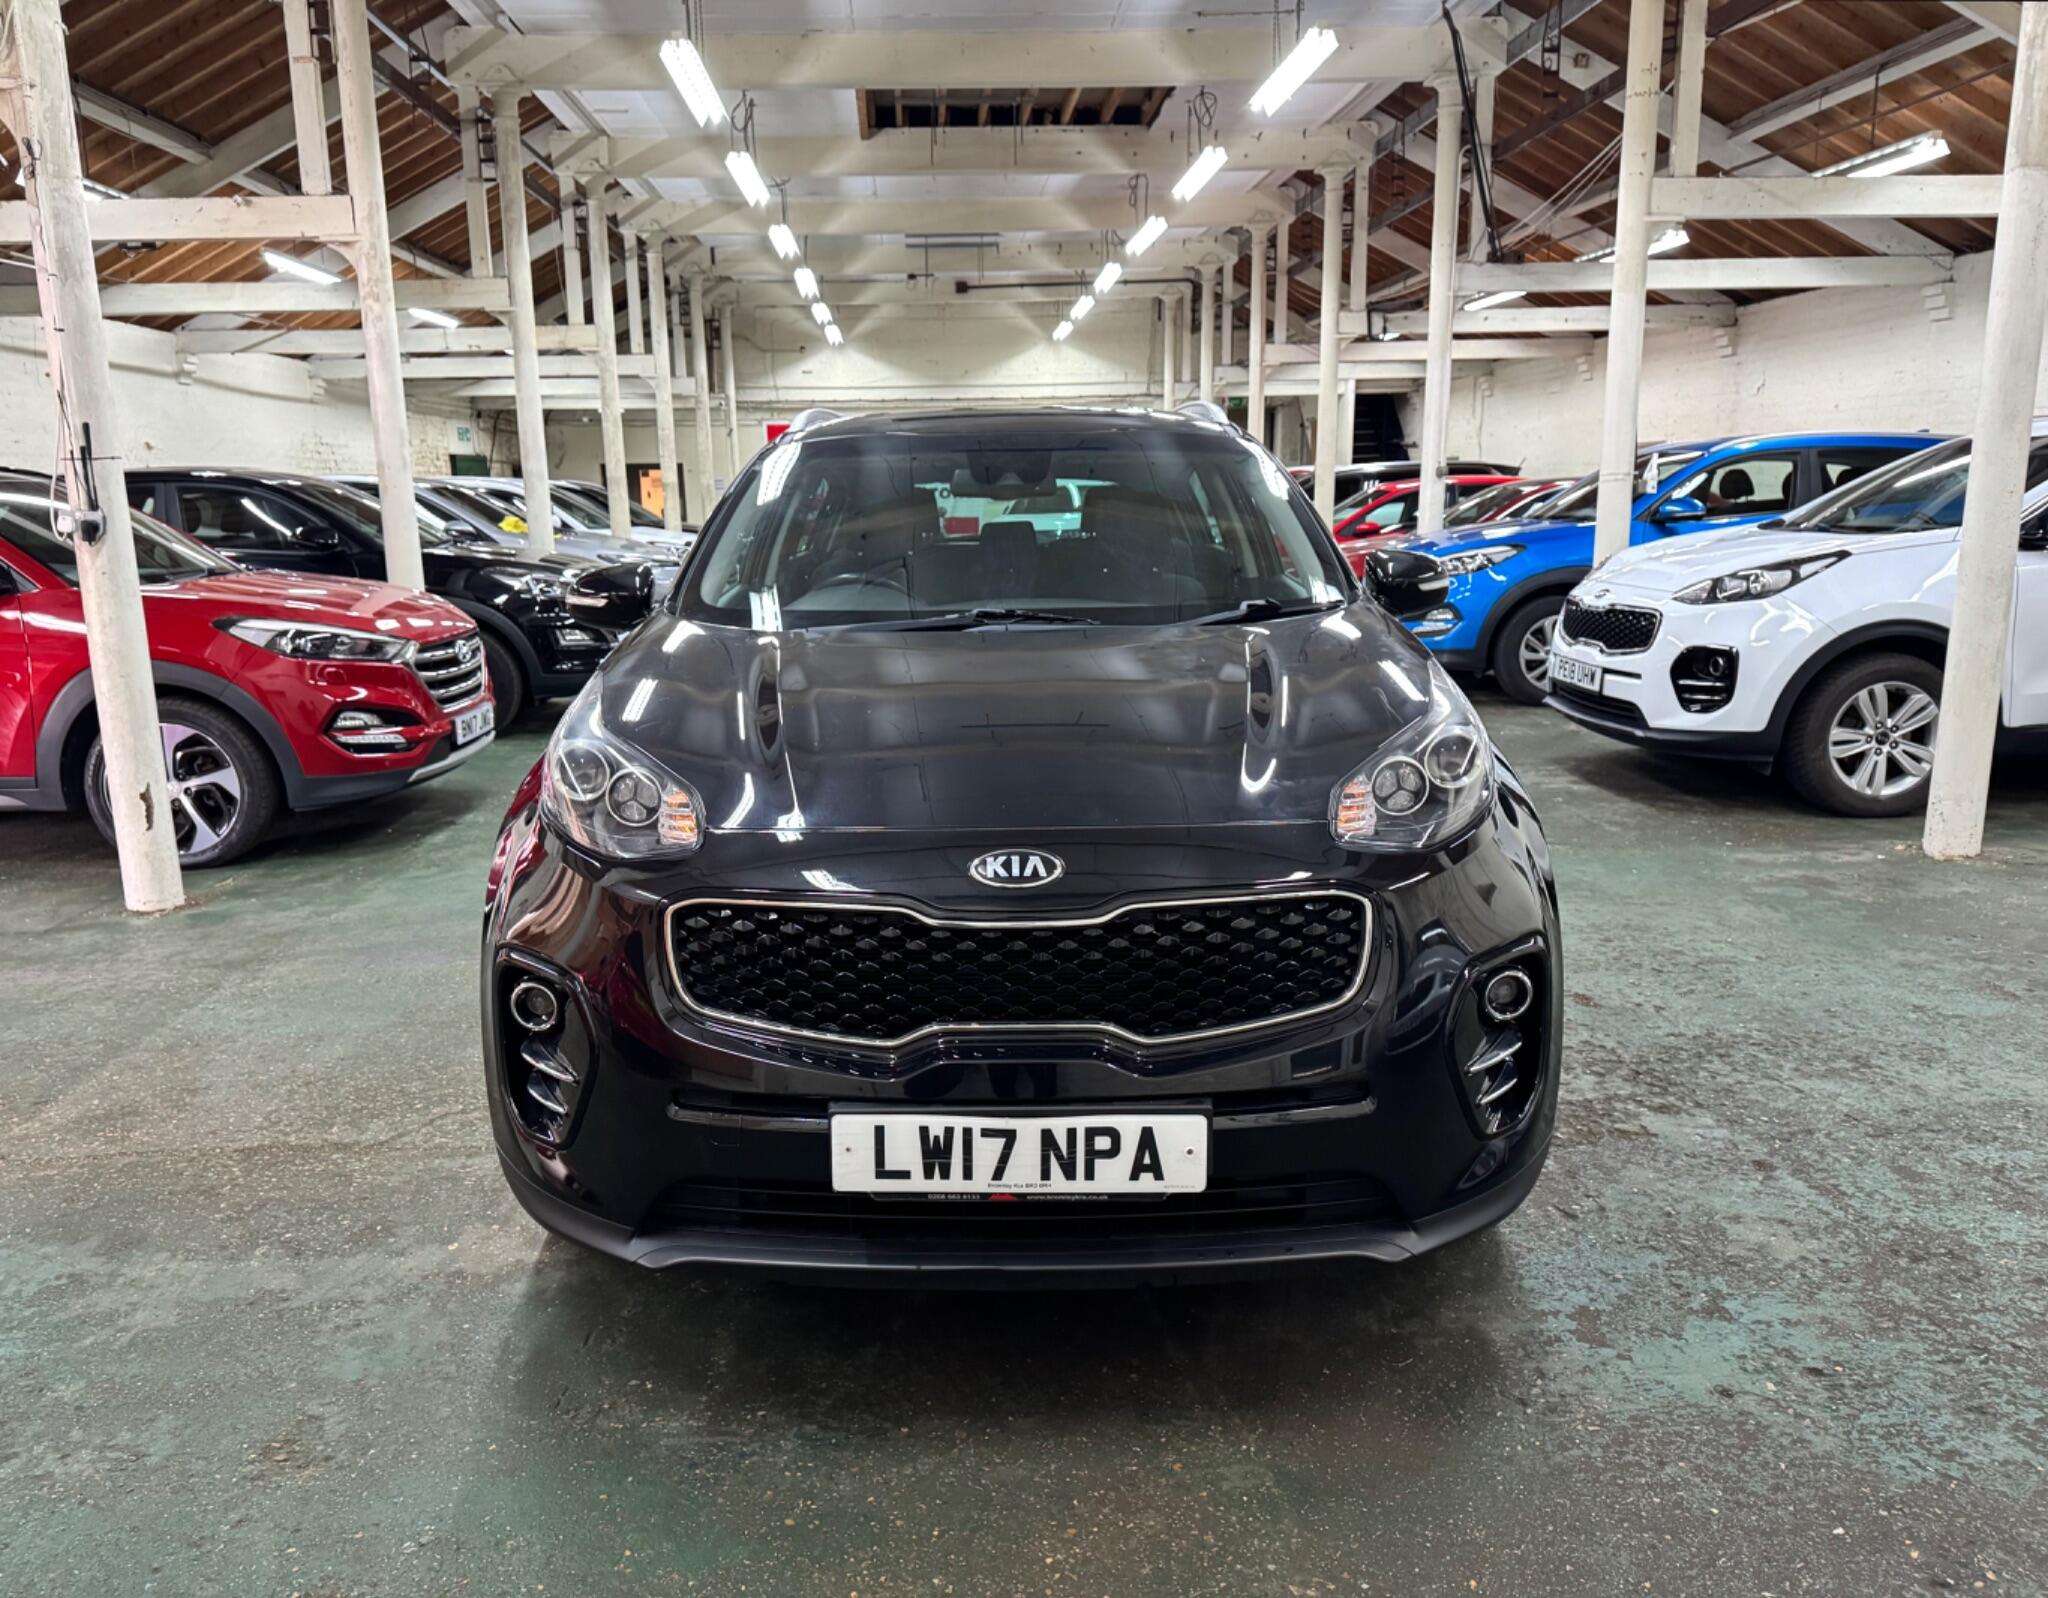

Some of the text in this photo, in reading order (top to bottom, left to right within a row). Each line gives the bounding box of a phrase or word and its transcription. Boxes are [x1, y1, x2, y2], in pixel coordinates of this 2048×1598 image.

[985, 855, 1047, 878] KIA
[874, 1125, 1164, 1181] LW17 NPA
